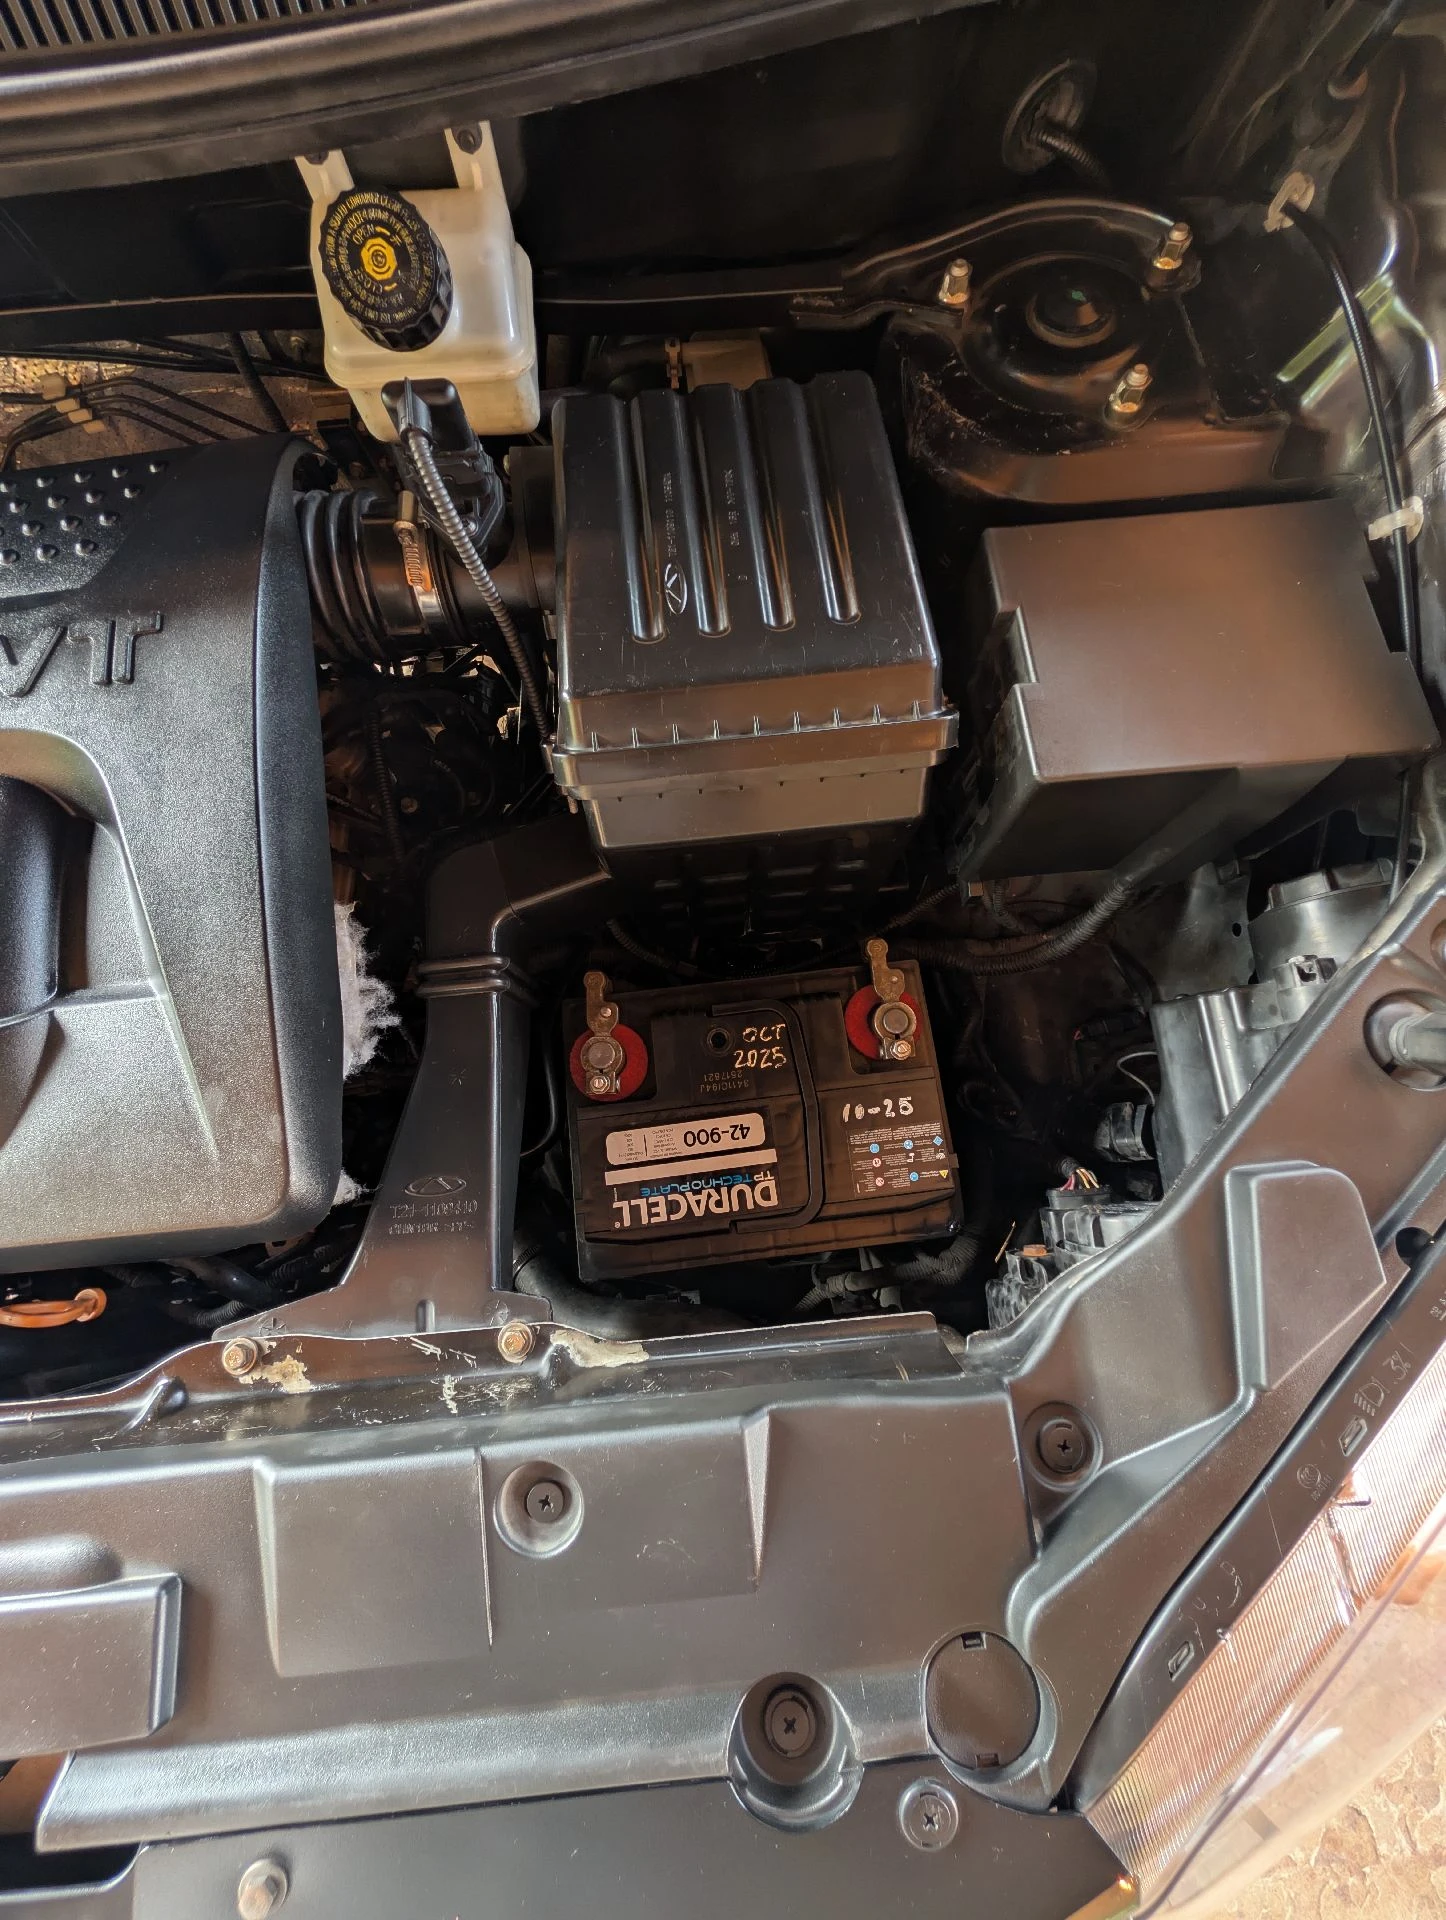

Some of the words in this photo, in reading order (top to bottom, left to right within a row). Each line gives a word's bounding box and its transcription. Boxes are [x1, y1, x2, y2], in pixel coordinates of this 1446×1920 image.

[352, 223, 376, 245] OPEN
[353, 266, 383, 295] CLOSE
[742, 1023, 786, 1042] OCT
[733, 1046, 787, 1069] 2025
[842, 1096, 914, 1123] 10-25
[683, 1123, 751, 1148] 42-900
[640, 1174, 753, 1197] TECHNOPLATE
[753, 1170, 775, 1181] TP
[612, 1180, 779, 1227] DURACELL
